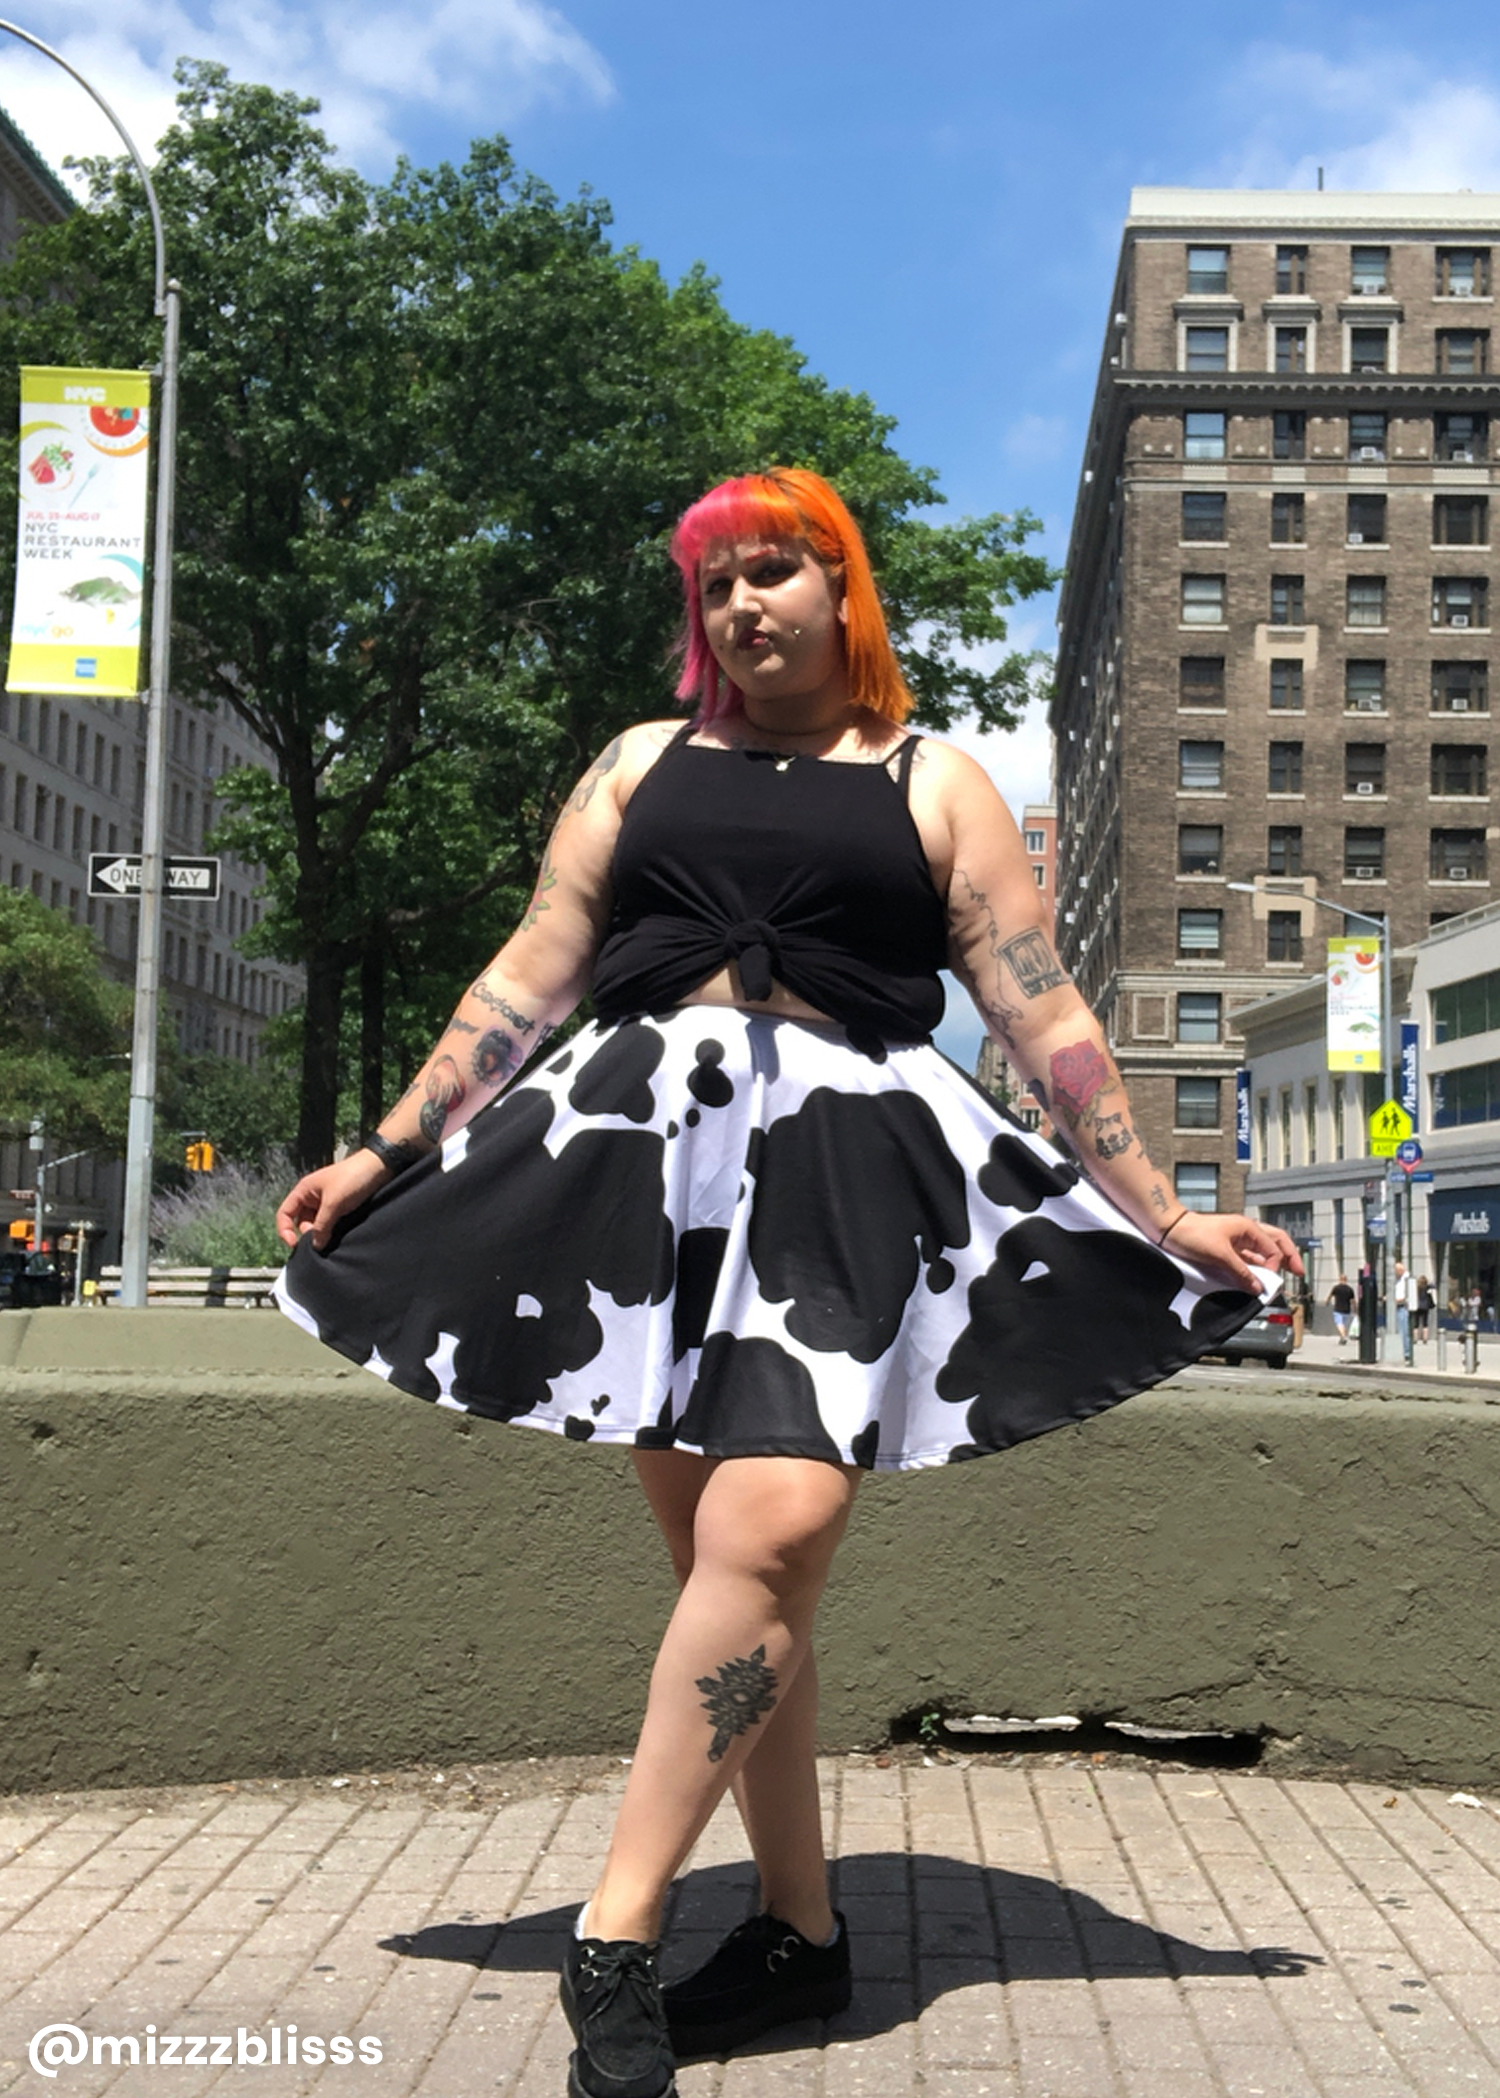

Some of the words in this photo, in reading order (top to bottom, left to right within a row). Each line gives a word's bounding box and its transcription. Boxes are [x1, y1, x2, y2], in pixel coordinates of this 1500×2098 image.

[63, 386, 106, 402] NYC
[24, 522, 58, 533] NYC
[24, 535, 141, 547] RESTAURANT
[23, 548, 73, 559] WEEK
[164, 870, 201, 886] WAY
[1402, 1043, 1416, 1114] Marshalls
[1237, 1087, 1249, 1145] Marshalls
[1450, 1211, 1490, 1235] Marshalls
